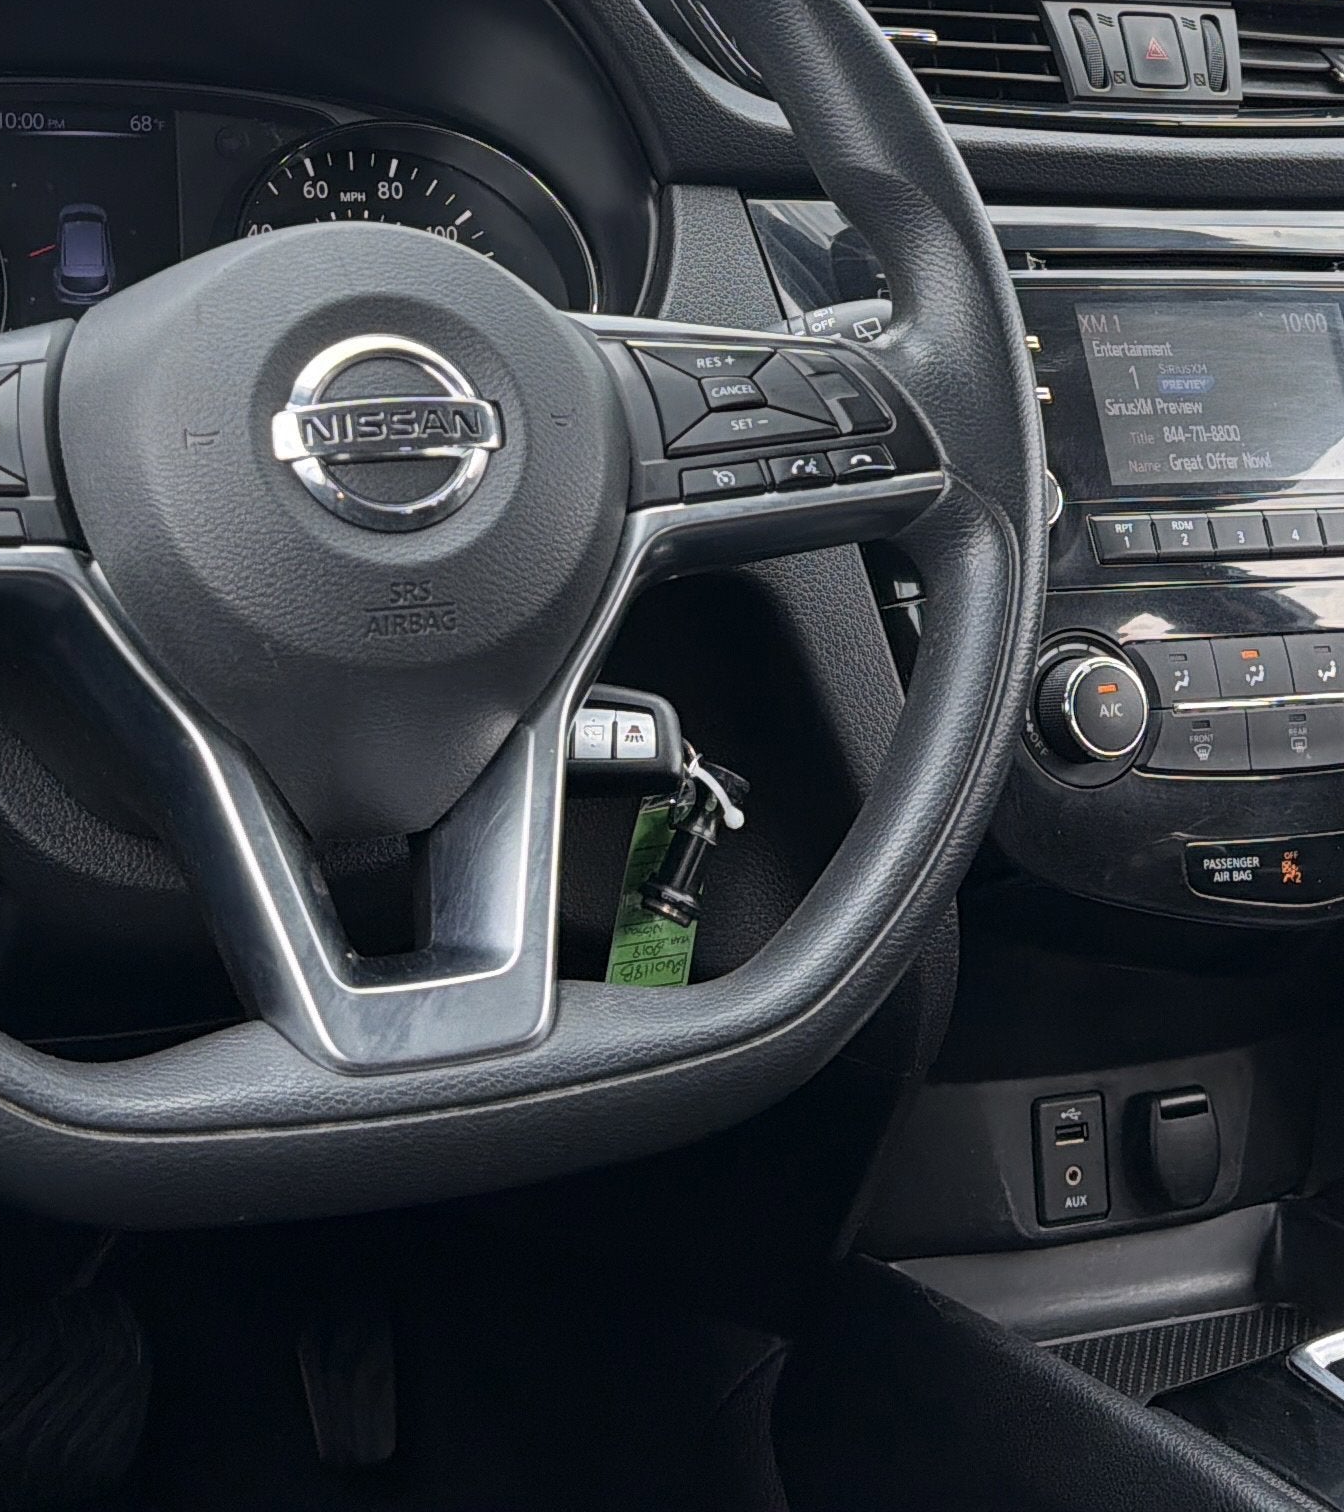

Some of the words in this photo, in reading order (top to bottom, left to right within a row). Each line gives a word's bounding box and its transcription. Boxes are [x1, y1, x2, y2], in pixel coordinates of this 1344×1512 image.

[303, 181, 329, 199] 60
[340, 191, 367, 203] MPH
[377, 181, 403, 200] 80
[811, 317, 836, 333] OFF
[1078, 314, 1108, 334] XM
[1113, 314, 1121, 333] 1
[1280, 312, 1328, 333] 10:00
[1092, 340, 1174, 358] Entertainment
[696, 356, 722, 369] RES
[1128, 365, 1140, 390] 1
[711, 384, 756, 398] CANCEL
[1105, 398, 1154, 416] SiriusXM
[1156, 397, 1203, 415] Preview
[302, 408, 483, 447] NISSAN
[730, 417, 753, 431] SET
[1128, 460, 1161, 473] Name
[1168, 453, 1203, 472] Great
[1206, 453, 1239, 470] Offer
[1242, 451, 1272, 469] Now!
[1115, 523, 1133, 534] RPT
[1171, 520, 1194, 531] RDM
[1180, 533, 1189, 546] 2
[1236, 530, 1245, 544] 3
[1291, 528, 1300, 541] 4
[1123, 535, 1130, 549] 1
[389, 581, 433, 604] SRS
[366, 610, 457, 639] AIRBAG
[1098, 702, 1123, 718] A/C
[1288, 726, 1308, 736] REAR
[1030, 730, 1049, 758] OFF
[1189, 733, 1214, 744] FRONT
[1283, 850, 1299, 860] OFF
[1202, 856, 1261, 870] PASSENGER
[1213, 871, 1231, 883] AIR
[1232, 870, 1253, 882] BAG
[1064, 1194, 1088, 1209] AUX
